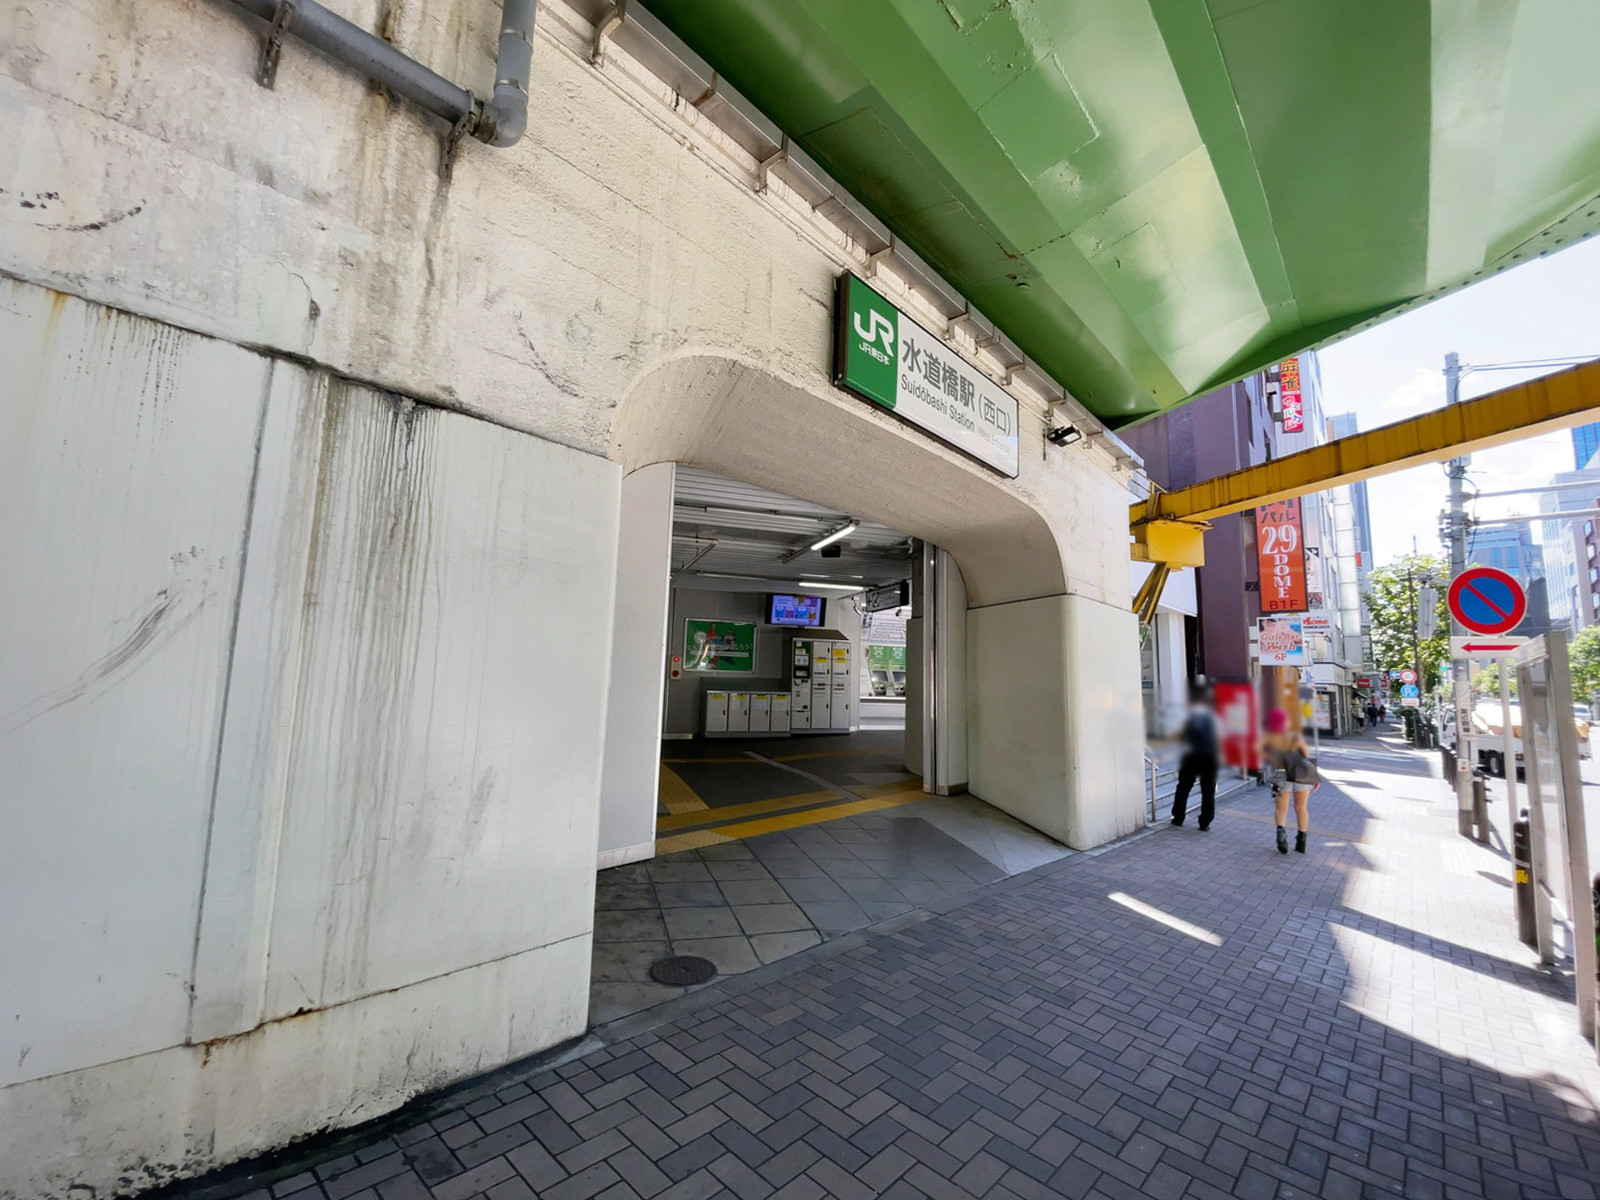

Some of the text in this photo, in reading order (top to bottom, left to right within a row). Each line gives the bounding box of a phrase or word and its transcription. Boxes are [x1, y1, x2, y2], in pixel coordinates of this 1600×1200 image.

[853, 308, 894, 358] JR
[858, 341, 890, 366] JR東日本
[949, 403, 975, 432] Station
[1262, 524, 1298, 555] 29
[1273, 553, 1292, 598] DOME
[1269, 600, 1298, 610] B1F
[1266, 640, 1296, 651] Wash
[1274, 652, 1287, 661] 6F
